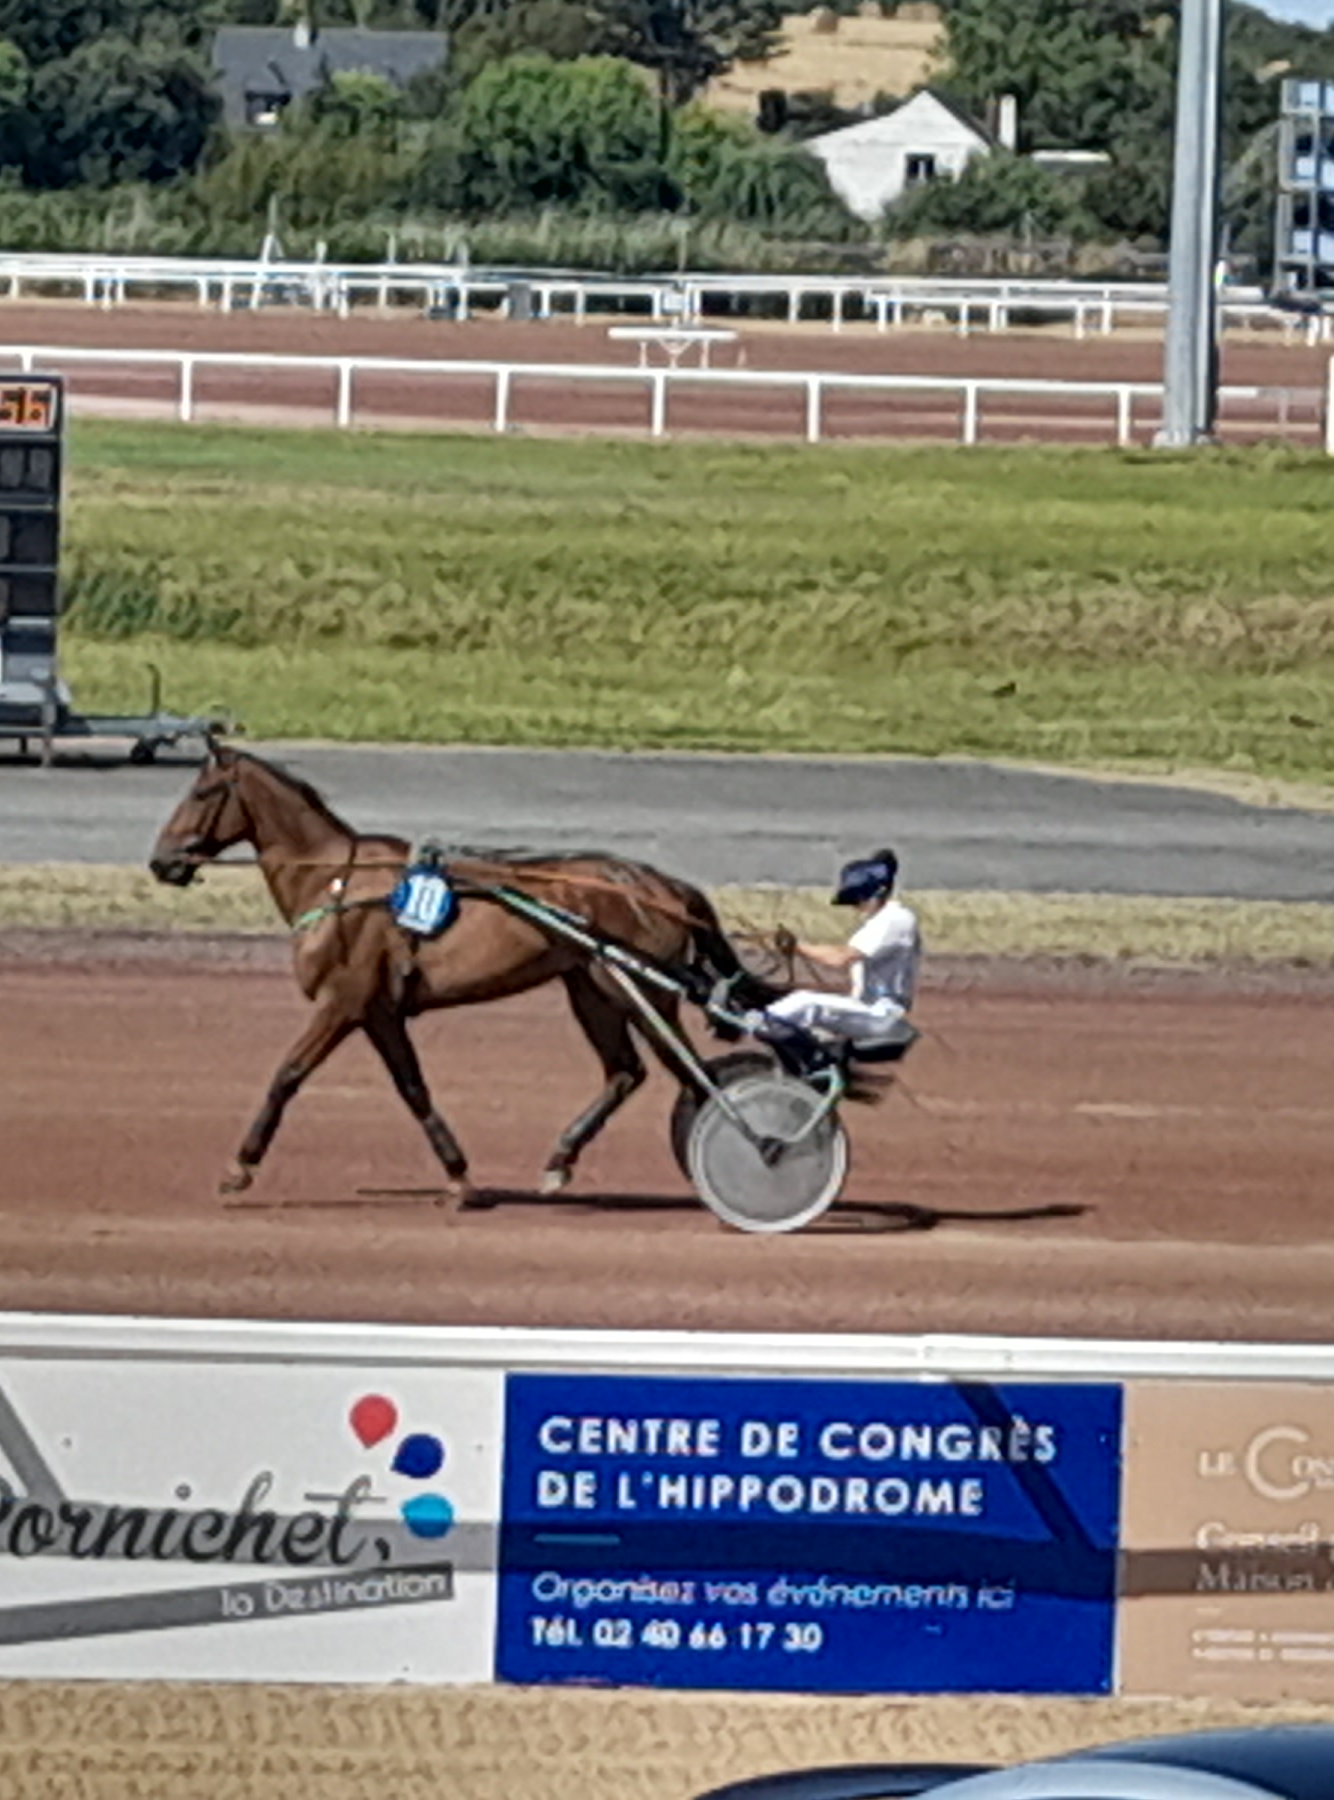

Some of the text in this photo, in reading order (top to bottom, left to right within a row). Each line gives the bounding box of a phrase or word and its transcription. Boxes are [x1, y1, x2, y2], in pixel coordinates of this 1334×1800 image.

[407, 875, 447, 921] 10
[539, 1415, 1058, 1462] CENTRE DE CONGRÈS
[1199, 1451, 1235, 1477] LE
[538, 1471, 985, 1517] DE L'HIPPODROME
[532, 1571, 695, 1610] Organisez
[705, 1583, 759, 1605] vos
[767, 1578, 969, 1609] événements
[592, 1620, 634, 1647] 02
[641, 1620, 681, 1648] 40
[688, 1621, 729, 1650] 66
[740, 1623, 773, 1650] 17
[782, 1623, 825, 1651] 30
